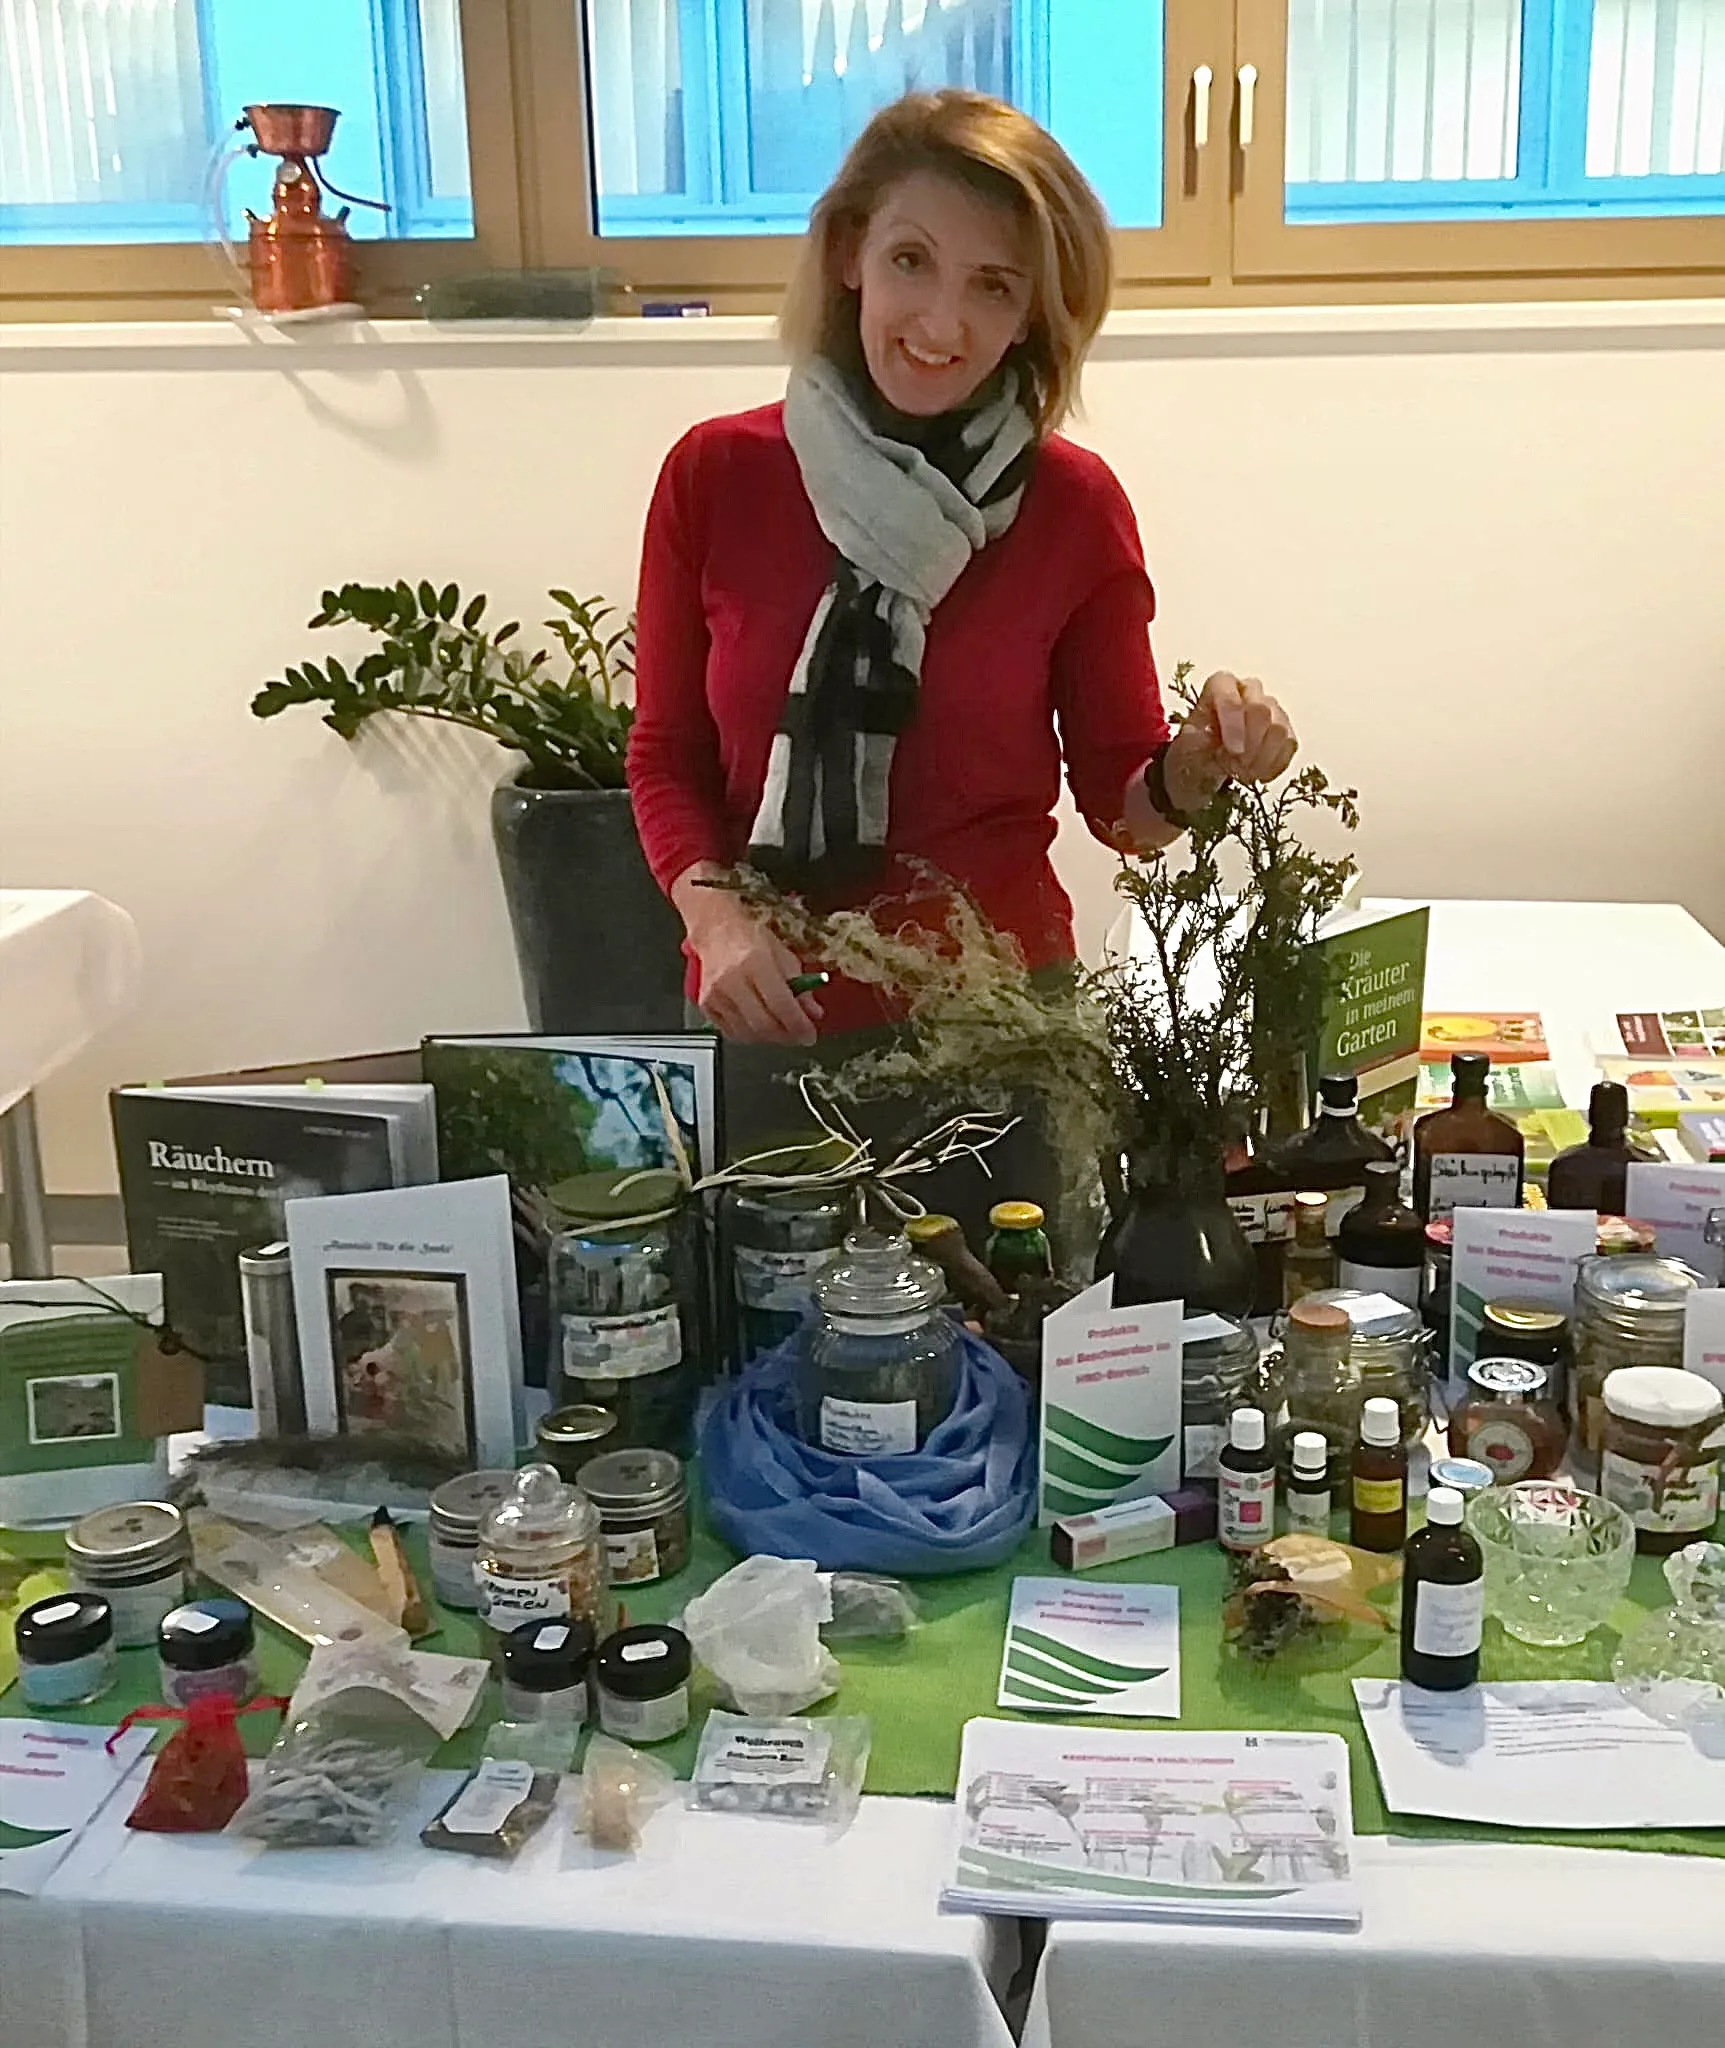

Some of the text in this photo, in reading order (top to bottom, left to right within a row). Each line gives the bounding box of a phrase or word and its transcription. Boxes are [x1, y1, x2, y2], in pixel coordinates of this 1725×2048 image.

[1348, 948, 1372, 972] Die
[1340, 961, 1410, 1003] Kräuter
[1345, 988, 1416, 1026] in meinem
[1336, 1018, 1397, 1057] Garten
[148, 1141, 275, 1178] Räuchern
